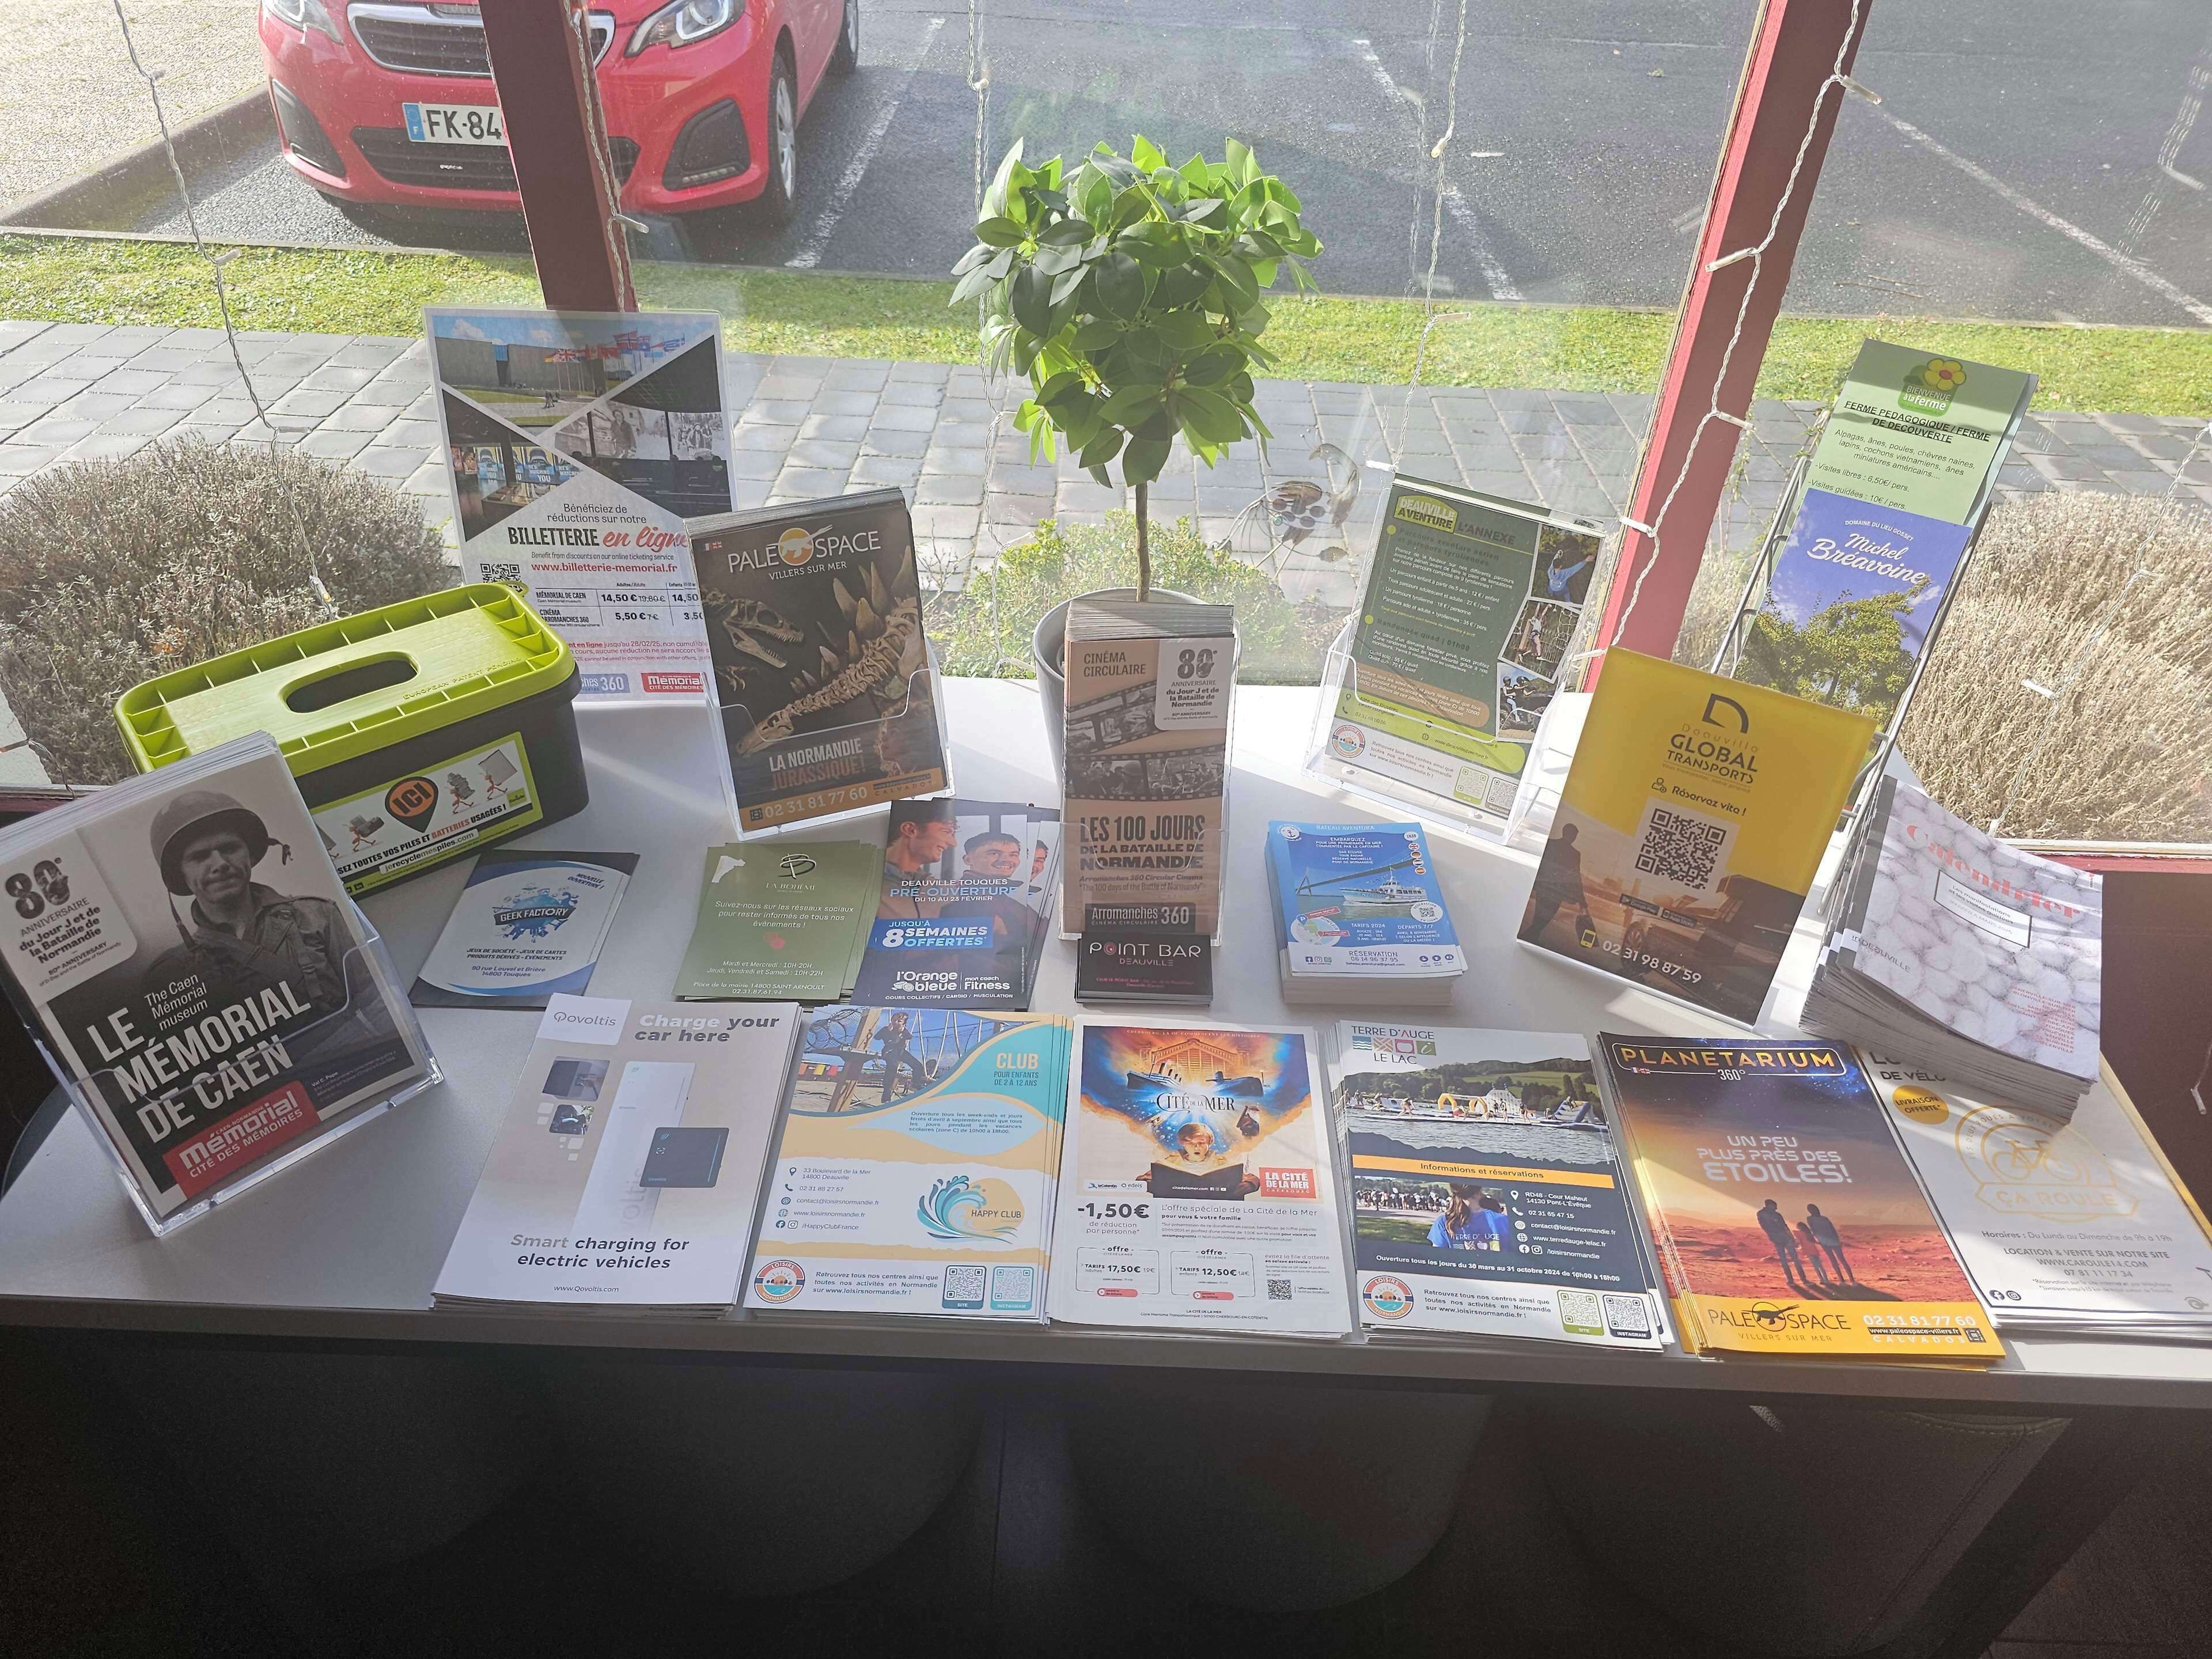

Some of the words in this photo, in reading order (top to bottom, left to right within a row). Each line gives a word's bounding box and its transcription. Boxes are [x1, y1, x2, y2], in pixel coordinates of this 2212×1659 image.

[1907, 385, 1952, 402] BIENVENUE
[1914, 396, 1946, 410] ferme
[1844, 400, 1877, 414] FERME
[1879, 409, 1948, 432] PEDAGOGIQUE
[1956, 427, 1991, 442] FERME
[1872, 418, 1885, 427] DE
[1887, 422, 1953, 443] DECOUVERTE
[564, 503, 613, 513] Bénéficiez
[616, 505, 627, 513] de
[1400, 498, 1456, 518] DEAUVILLE
[547, 513, 599, 523] réductions
[620, 515, 646, 524] notre
[1398, 507, 1453, 529] AVENTURE
[507, 527, 600, 546] BILLETTERIE
[603, 531, 631, 548] en
[1458, 521, 1516, 545] L'ANNEXE
[1881, 524, 1892, 532] LIEU
[1893, 528, 1914, 542] GOSSET
[1844, 533, 1908, 560] Michel
[531, 563, 677, 573] www.billetterie-memorial.fr
[1807, 539, 1925, 584] Bréavoine
[768, 567, 805, 580] VILLERS
[807, 565, 825, 574] SUR
[828, 562, 847, 571] MER
[601, 594, 631, 603] 14,50
[1084, 650, 1126, 664] CINÉMA
[1084, 664, 1146, 677] CIRCULAIRE
[769, 755, 786, 772] LA
[787, 738, 863, 767] NORMANDIE
[1671, 734, 1758, 772] GLOBAL
[1668, 749, 1753, 783] TRANSPORTS
[392, 782, 432, 815] ICI
[1672, 786, 1718, 807] Réservez
[1721, 802, 1740, 814] vite
[1081, 817, 1109, 842] LES
[1114, 816, 1146, 841] 100
[1150, 815, 1205, 840] JOURS
[352, 853, 382, 869] TOUTES
[382, 845, 399, 858] VOS
[400, 840, 421, 853] PILES
[422, 836, 430, 844] ET
[431, 819, 470, 839] BATTERIES
[470, 807, 502, 823] USAGÉES
[385, 832, 474, 872] jerecyclemespiles.com
[1080, 846, 1097, 854] DE
[1120, 844, 1184, 853] BATAILLE
[1187, 844, 1203, 852] DE
[1081, 856, 1203, 870] NORMANDIE
[890, 887, 1018, 897] PRÉ-OUVERTURE
[715, 901, 761, 909] Suivez-nous
[501, 911, 522, 922] GEEK
[524, 908, 569, 918] FACTORY
[1092, 907, 1158, 919] Arromanches
[1161, 907, 1188, 925] 360
[882, 929, 904, 948] 8
[904, 926, 987, 937] SEMAINES
[1159, 945, 1201, 957] BAR
[1603, 941, 1621, 955] 02
[1623, 948, 1638, 961] 31
[1642, 955, 1659, 968] 98
[1662, 962, 1681, 975] 87
[1683, 969, 1702, 983] 59
[897, 972, 957, 982] l'Orange
[144, 990, 167, 1007] The
[169, 974, 198, 994] Caen
[915, 982, 957, 991] bleue
[964, 981, 1010, 990] Fitness
[151, 983, 207, 1019] Mémorial
[159, 999, 207, 1031] museum
[554, 1012, 616, 1026] Qovoltis
[639, 1014, 720, 1030] Charge
[727, 1017, 779, 1030] your
[87, 1007, 145, 1062] LE
[634, 1031, 671, 1041] car
[679, 1029, 730, 1041] here
[1351, 1025, 1387, 1036] TERRE
[1389, 1028, 1435, 1040] D'AUGE
[113, 980, 311, 1104] MÉMORIAL
[995, 1052, 1039, 1069] CLUB
[1374, 1053, 1388, 1062] LE
[1392, 1054, 1417, 1065] LAC
[1621, 1048, 1835, 1067] PLANETARIUM
[1717, 1069, 1745, 1081] 360°
[1880, 1071, 1902, 1081] DE
[137, 1087, 195, 1143] DE
[192, 1034, 293, 1109] CAEN
[1895, 1096, 1938, 1105] LIVRAISON
[179, 1091, 298, 1169] mémorial
[190, 1158, 215, 1177] CITÉ
[218, 1145, 240, 1161] DES
[243, 1109, 302, 1146] MÉMOIRES
[1727, 1135, 1756, 1146] UN
[1759, 1137, 1797, 1147] PEU
[1696, 1148, 1745, 1160] PLUS
[1749, 1148, 1799, 1161] PRÈS
[1802, 1151, 1841, 1162] DES
[1265, 1172, 1277, 1181] LA
[1282, 1172, 1308, 1181] CITÉ
[1421, 1163, 1476, 1174] Informations
[1488, 1169, 1544, 1179] réservations
[1703, 1162, 1852, 1183] ETOILES!
[972, 1210, 998, 1218] HAPPY
[1078, 1203, 1150, 1219] -1,50€
[1162, 1205, 1188, 1213] L'offre
[1531, 1223, 1616, 1236] contact@loisirsnormandie.fr
[511, 1234, 569, 1248] Smart
[575, 1237, 656, 1252] charging
[663, 1238, 690, 1250] for
[1533, 1236, 1606, 1247] www.terredauge-lelac.fr
[517, 1253, 588, 1267] electric
[596, 1256, 671, 1268] vehicles
[2003, 1248, 2051, 1256] LOCATION
[2065, 1249, 2093, 1257] VENTE
[1107, 1265, 1141, 1273] 17,50€
[1202, 1268, 1237, 1276] 12,50€
[1869, 1327, 1960, 1335] www.paleospace-villers.fr
